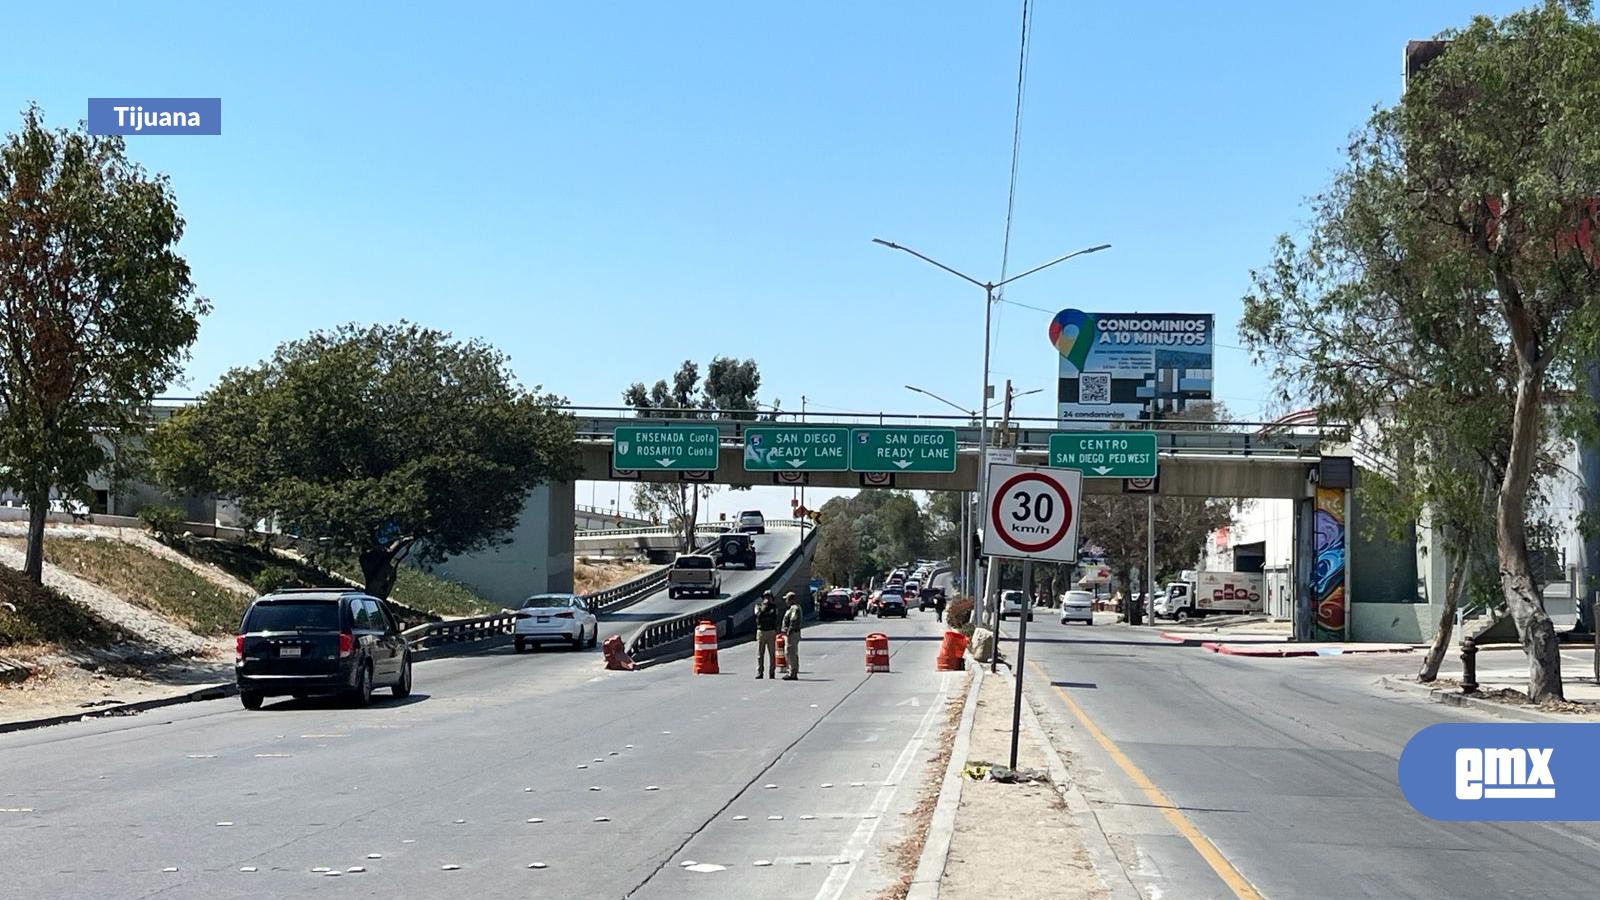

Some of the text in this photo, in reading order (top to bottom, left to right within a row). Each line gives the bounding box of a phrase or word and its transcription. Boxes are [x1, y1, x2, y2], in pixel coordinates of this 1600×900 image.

[1097, 319, 1206, 331] CONDOMINIOS
[1099, 332, 1206, 345] A 10 MINUTOS
[1063, 410, 1125, 418] 24 condominios
[636, 432, 714, 443] ENSENADA Cuota
[753, 437, 760, 446] 5
[776, 433, 836, 444] SAN DIEGO
[860, 434, 867, 444] 5
[885, 434, 944, 445] SAN DIEGO
[1079, 439, 1128, 450] CENTRO
[637, 446, 713, 456] ROSARITO Cuota
[771, 446, 807, 457] READY
[815, 447, 843, 457] LANE
[877, 447, 949, 458] READY LANE
[1056, 453, 1075, 463] SAN
[1079, 453, 1105, 464] DIEGO
[1011, 491, 1054, 523] 30
[1011, 523, 1050, 535] km/h
